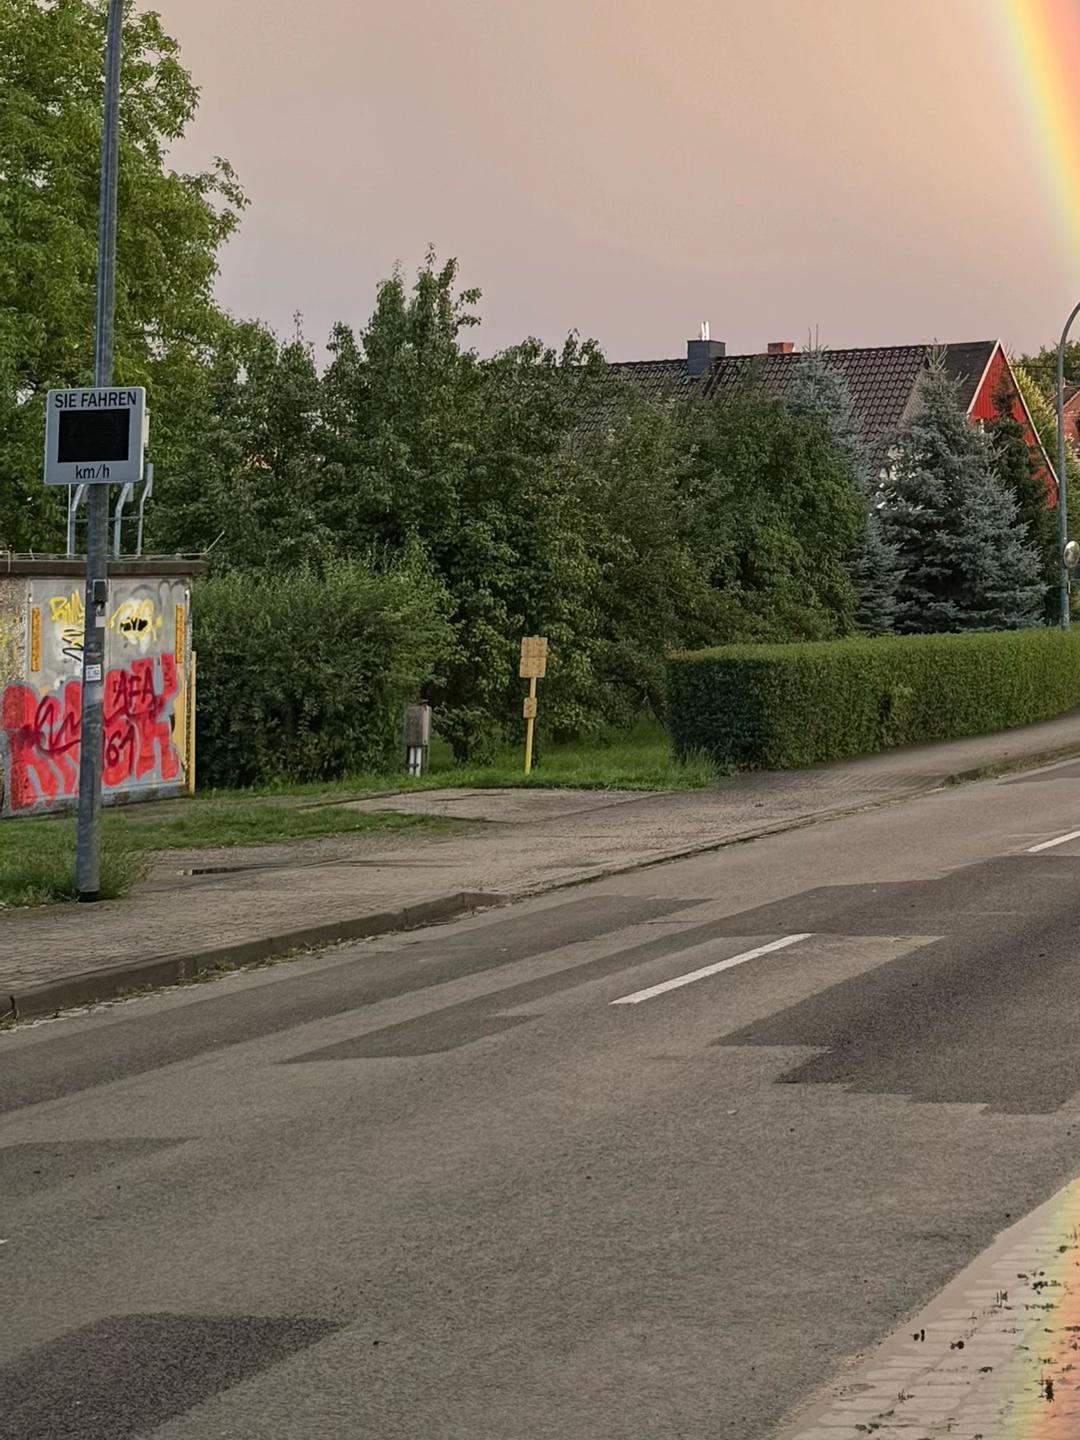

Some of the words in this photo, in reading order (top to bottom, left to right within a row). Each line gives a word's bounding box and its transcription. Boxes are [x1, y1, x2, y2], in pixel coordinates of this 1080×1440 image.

[55, 393, 77, 408] SIE
[81, 391, 137, 407] FAHREN
[75, 464, 110, 479] km/h
